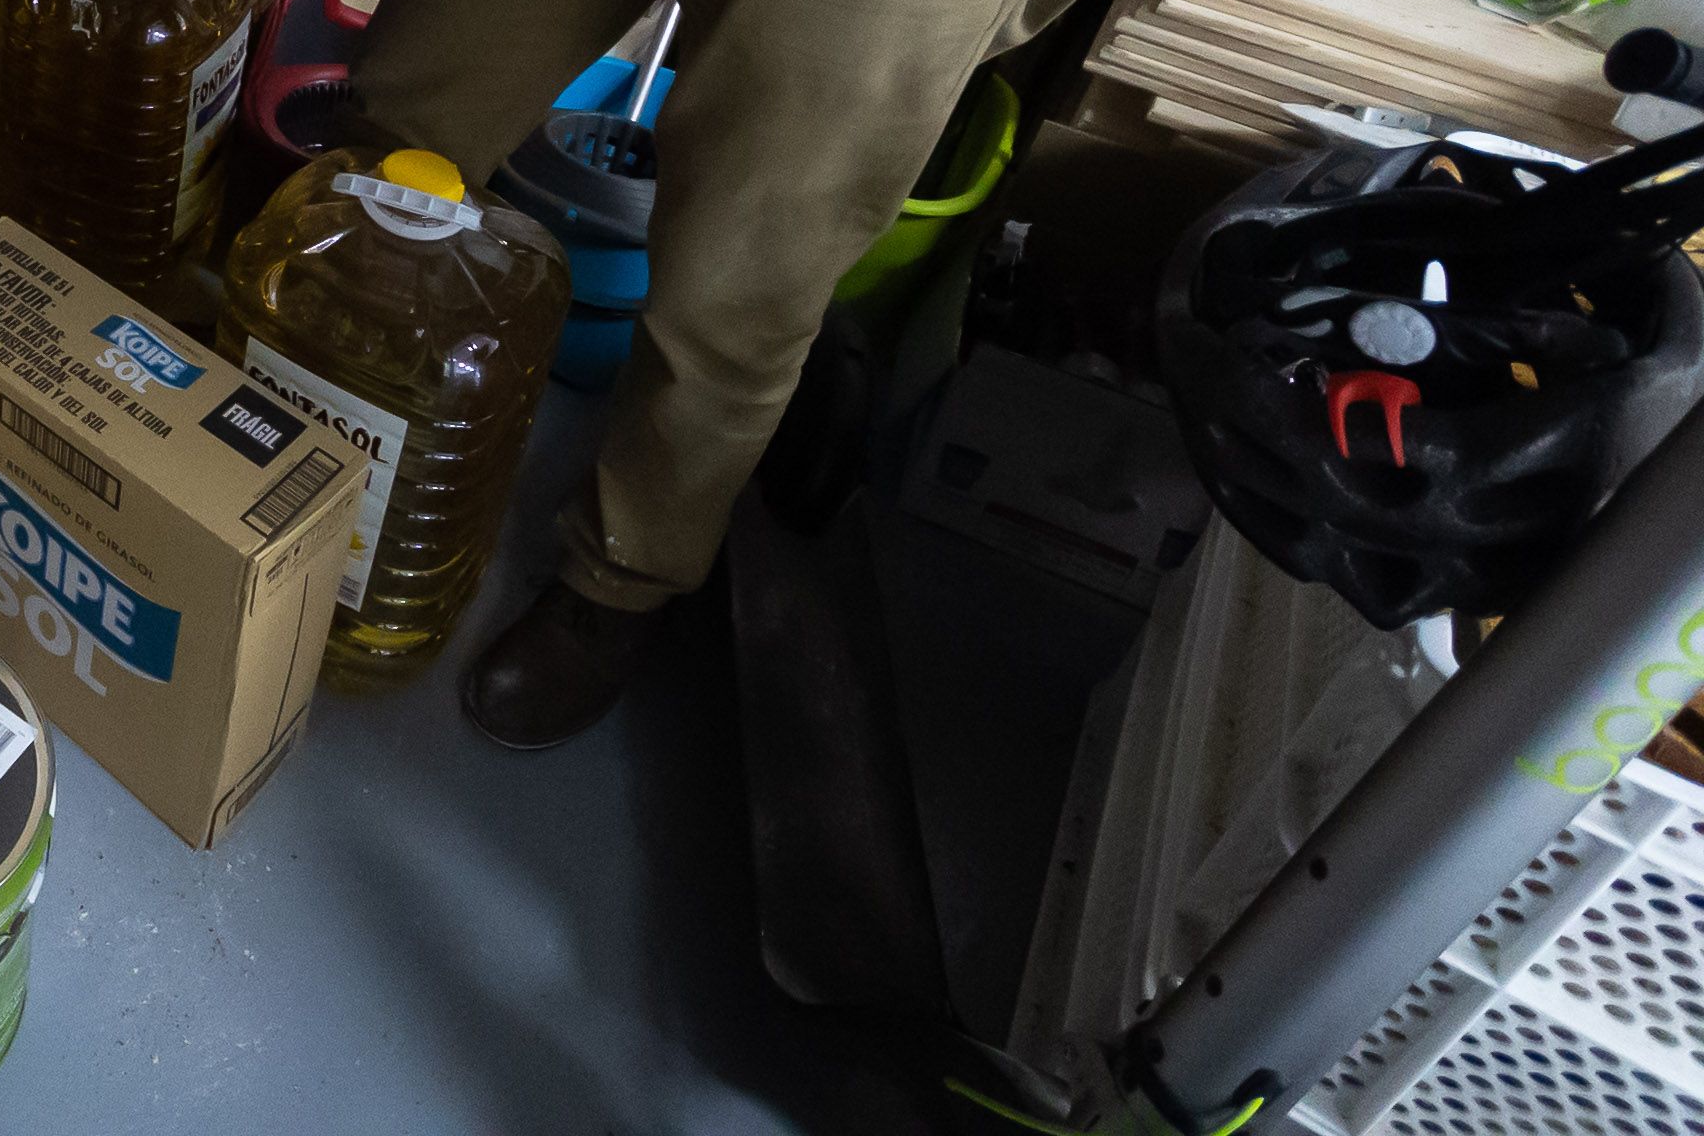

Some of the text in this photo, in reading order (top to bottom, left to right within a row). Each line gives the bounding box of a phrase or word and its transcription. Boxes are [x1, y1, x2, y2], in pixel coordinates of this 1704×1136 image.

[39, 268, 60, 288] DE
[56, 279, 68, 290] 5
[95, 347, 154, 394] SOL
[109, 321, 188, 380] KOIPE
[12, 362, 54, 394] CALOR
[50, 387, 63, 401] Y
[59, 395, 85, 417] DEL
[81, 410, 109, 434] SOL
[17, 325, 46, 349] MÁS
[42, 343, 63, 360] DE
[58, 355, 72, 367] 4
[69, 362, 112, 395] CAJAS
[107, 389, 129, 406] DE
[123, 401, 173, 439] ALTURA
[221, 402, 283, 450] FRÁGIL
[6, 459, 71, 516] REFINADO
[76, 513, 92, 533] DE
[97, 529, 156, 584] GIRASOL
